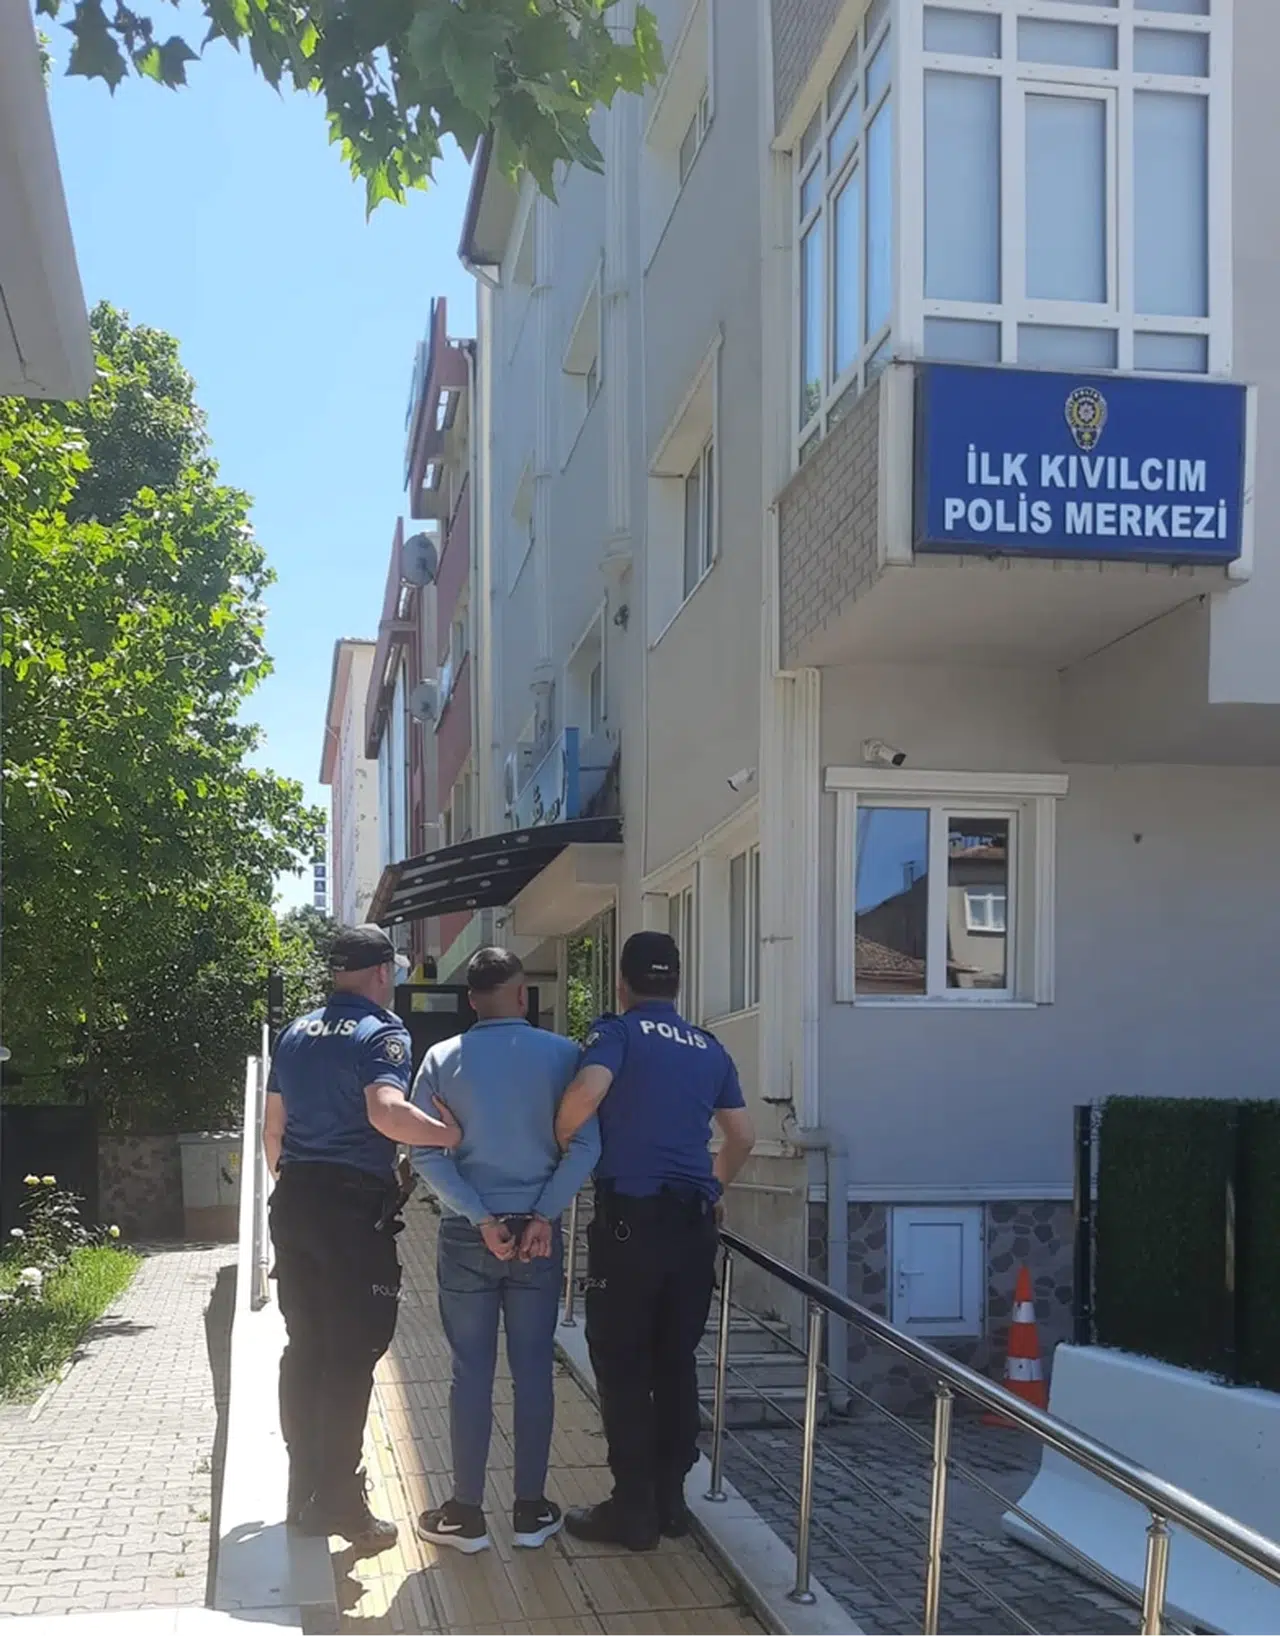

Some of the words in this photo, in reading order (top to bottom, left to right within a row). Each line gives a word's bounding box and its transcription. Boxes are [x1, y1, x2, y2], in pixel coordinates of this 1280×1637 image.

[967, 443, 1028, 487] İLK
[1040, 453, 1206, 492] KIVILCIM
[944, 493, 1052, 535] POLİS
[1065, 499, 1227, 539] MERKEZİ
[640, 1020, 708, 1049] POLİS
